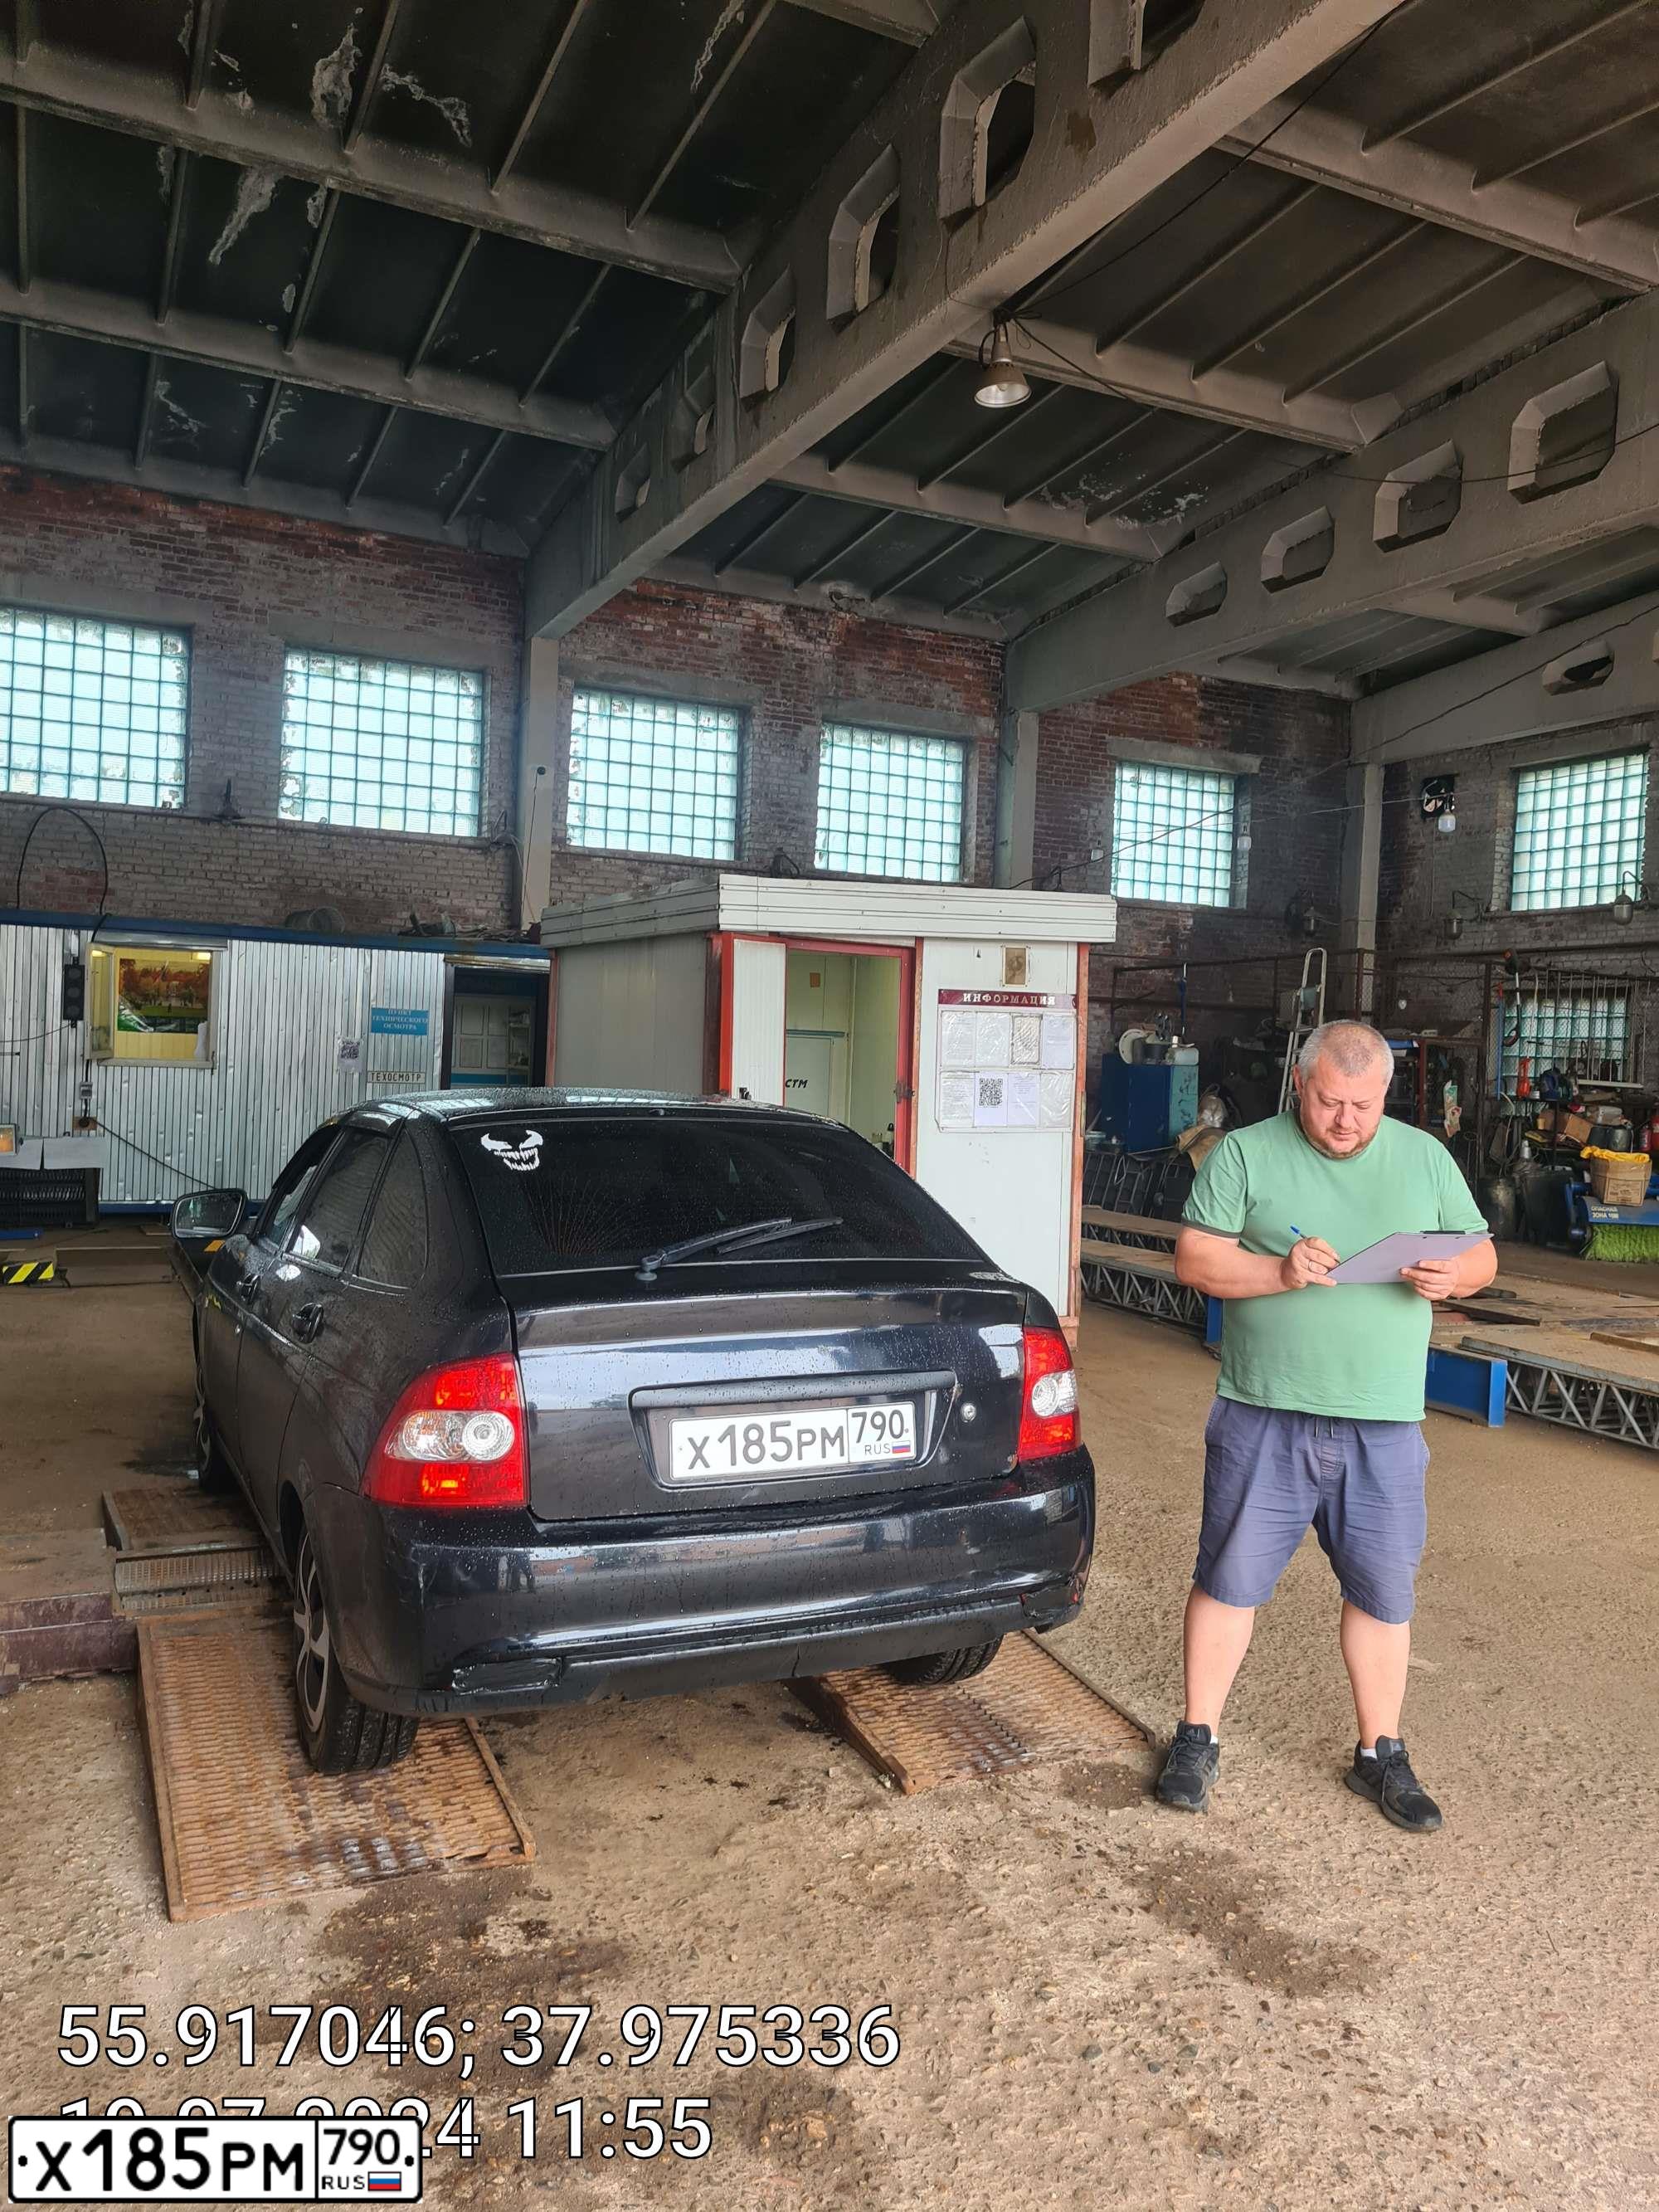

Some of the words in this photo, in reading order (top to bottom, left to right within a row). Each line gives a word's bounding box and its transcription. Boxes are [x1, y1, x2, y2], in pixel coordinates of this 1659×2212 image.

[962, 992, 1056, 1006] ИНФОРМАЦИЯ
[372, 1015, 428, 1024] ТЕХНИЧЕСКОГО
[371, 1072, 421, 1082] ТЕХОСМОТР
[851, 1409, 905, 1444] 790
[864, 1444, 892, 1456] RUS
